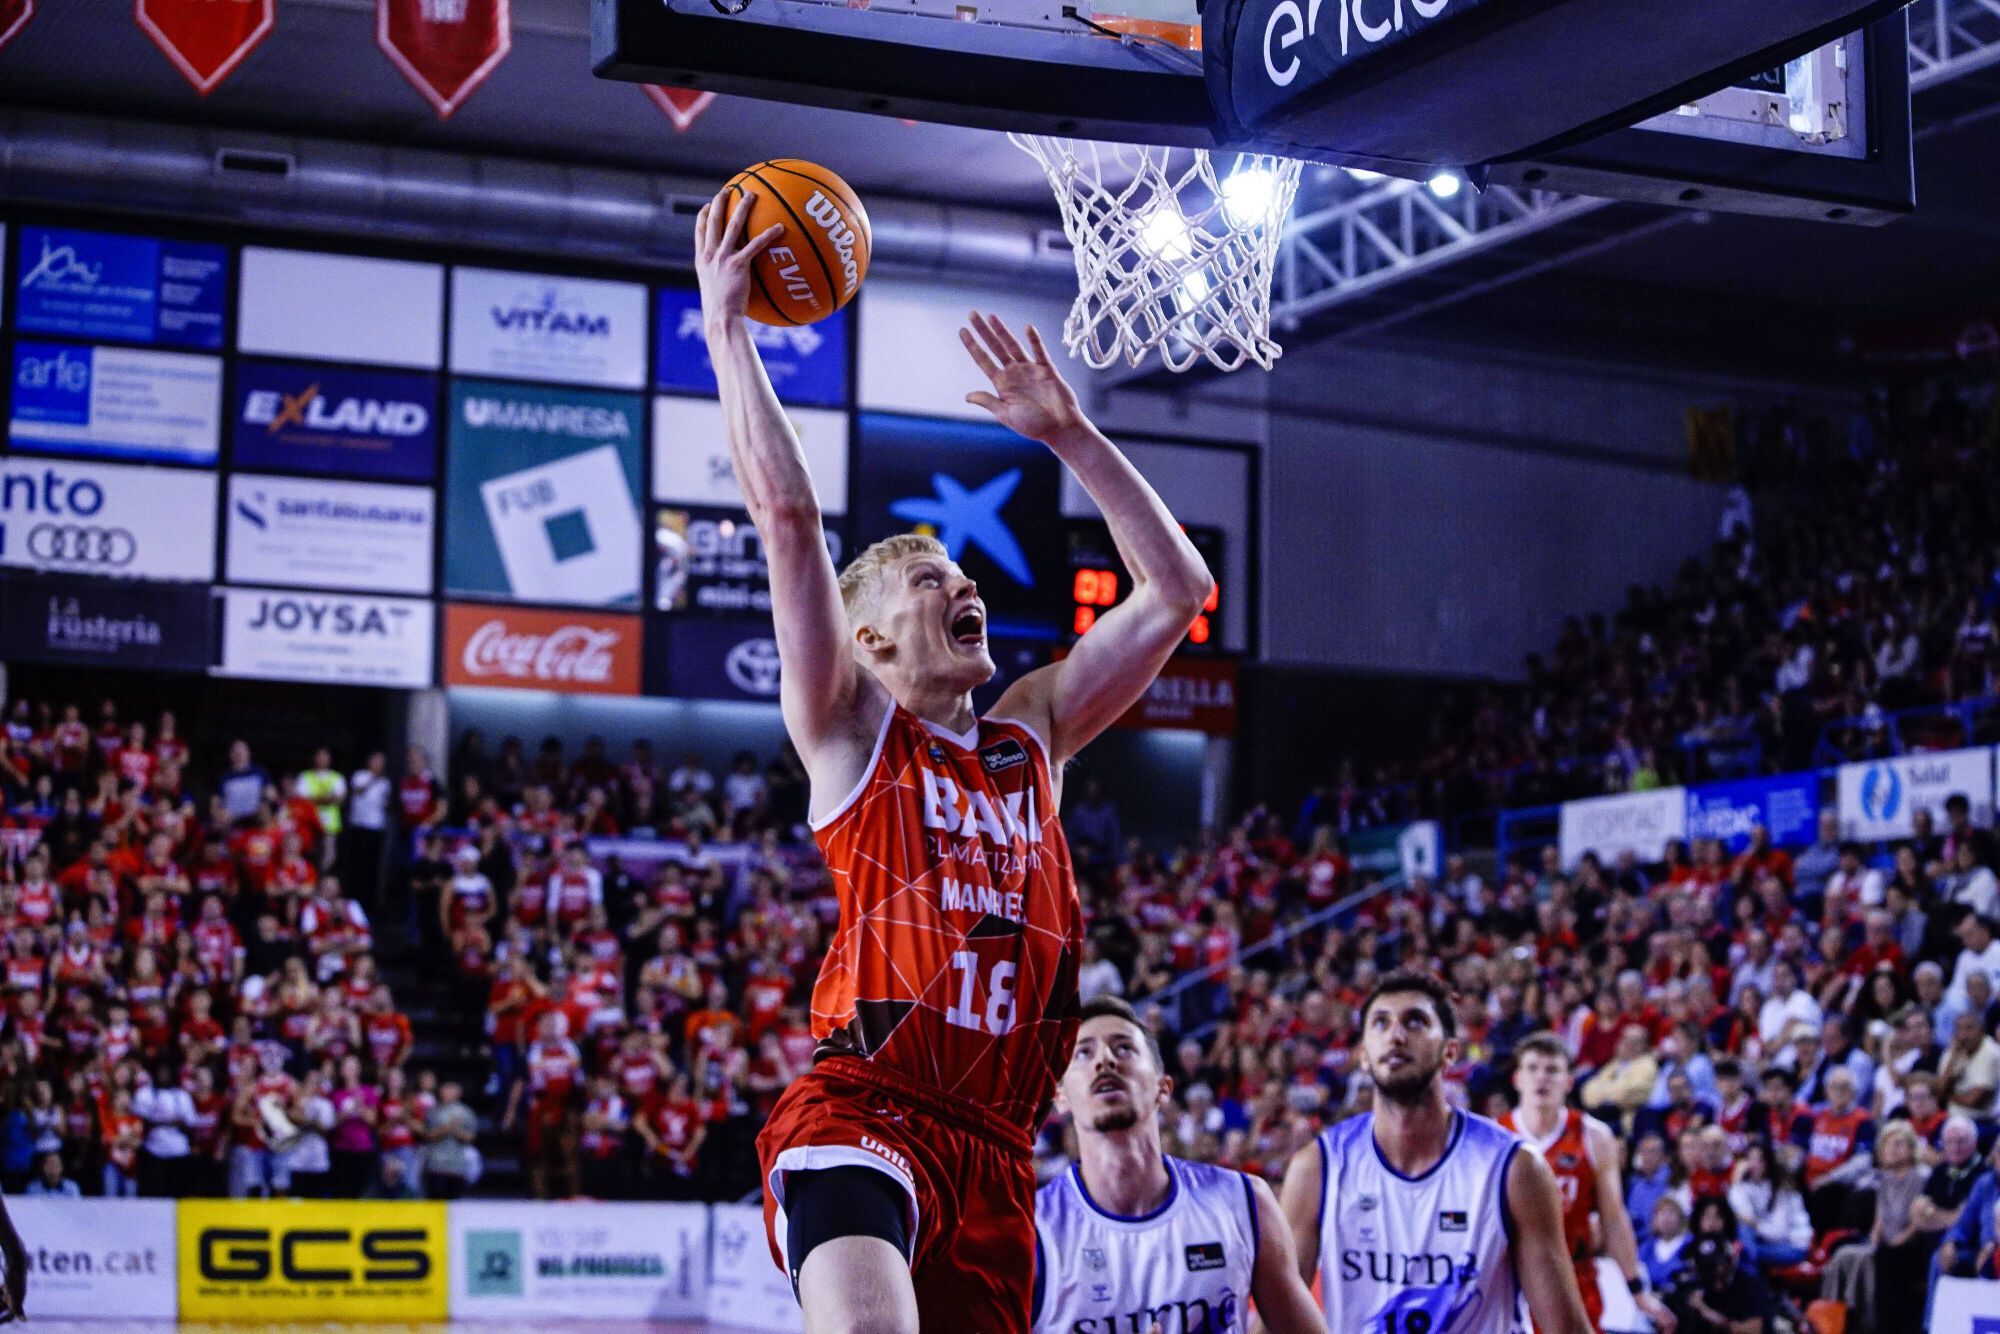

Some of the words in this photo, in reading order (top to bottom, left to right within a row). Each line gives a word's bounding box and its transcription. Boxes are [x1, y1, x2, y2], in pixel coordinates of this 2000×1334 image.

[805, 190, 858, 296] Wilson
[769, 246, 814, 301] EVO
[491, 302, 611, 338] VITAM
[244, 383, 428, 436] EXLAND
[464, 397, 632, 439] UMANRESA
[499, 477, 559, 521] FUB
[462, 621, 620, 684] Coca-Cola
[945, 950, 1017, 1036] 18
[200, 1228, 430, 1282] GCS
